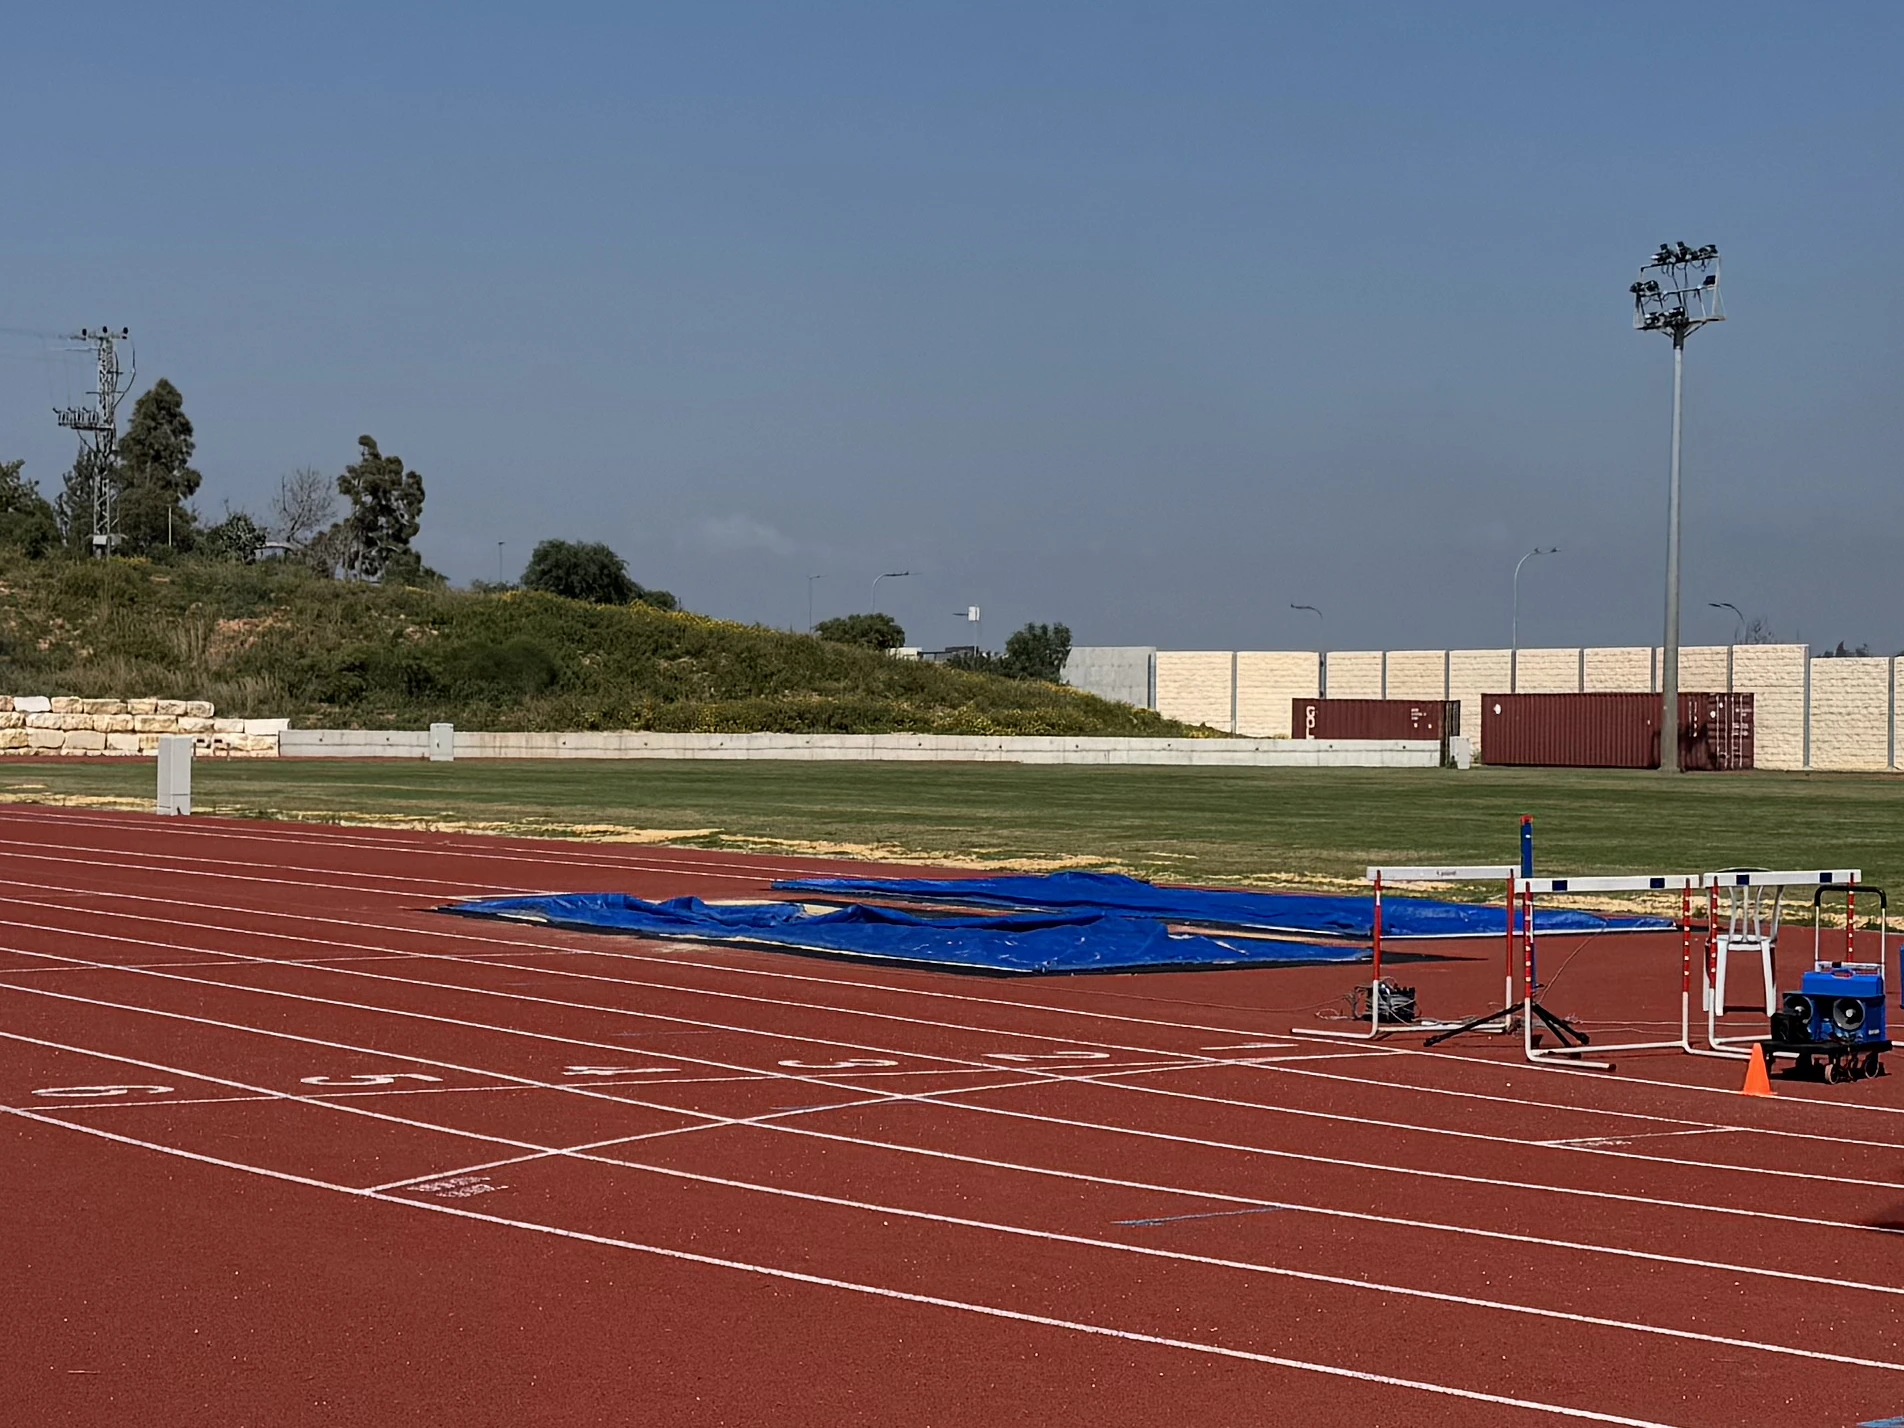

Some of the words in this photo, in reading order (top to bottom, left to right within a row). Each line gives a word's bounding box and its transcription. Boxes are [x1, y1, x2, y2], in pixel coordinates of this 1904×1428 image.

[980, 1050, 1111, 1062] 2
[777, 1058, 899, 1069] 3
[300, 1073, 444, 1086] 5
[30, 1084, 175, 1098] 6
